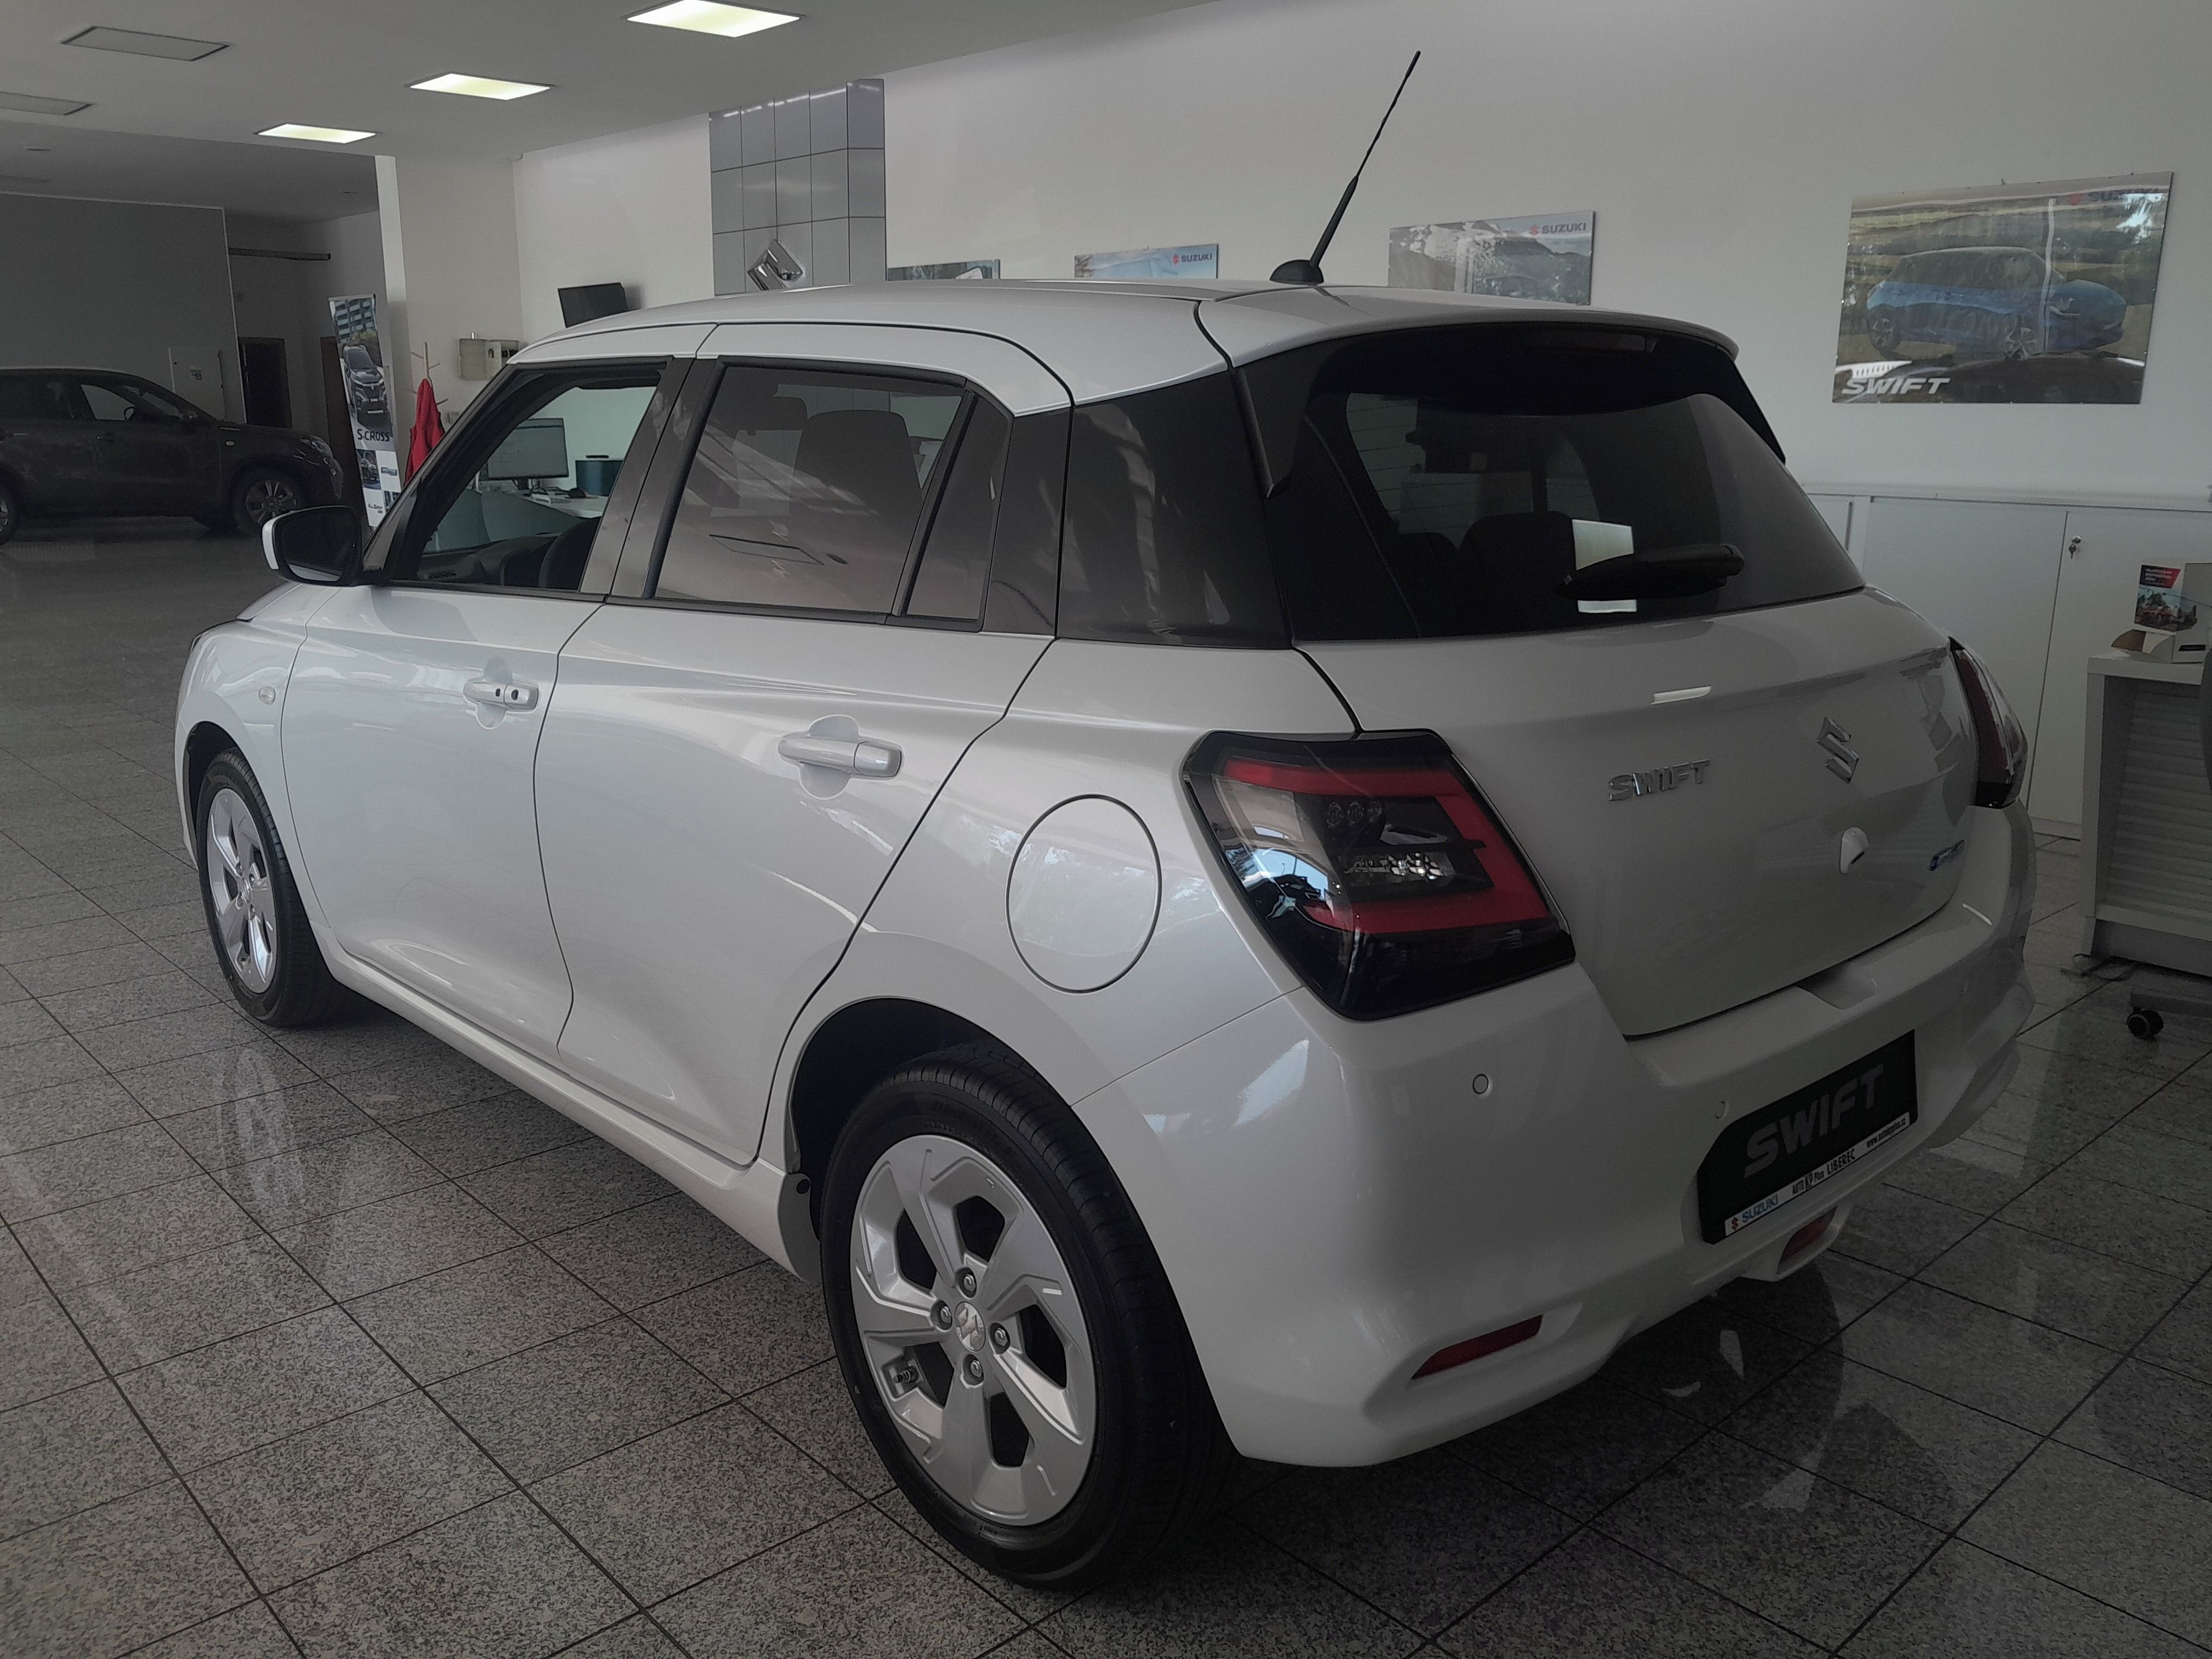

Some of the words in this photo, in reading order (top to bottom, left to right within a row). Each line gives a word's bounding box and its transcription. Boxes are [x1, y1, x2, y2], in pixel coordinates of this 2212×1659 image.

[1542, 222, 1586, 234] SUZUKI
[1181, 253, 1212, 262] SUZUKI
[1841, 376, 1951, 395] SWIFT
[1608, 759, 1710, 801] SWIFT
[1744, 1063, 1884, 1179] SWIFT
[1742, 1194, 1779, 1223] SUZUKI
[1827, 1148, 1856, 1174] LIBEREC
